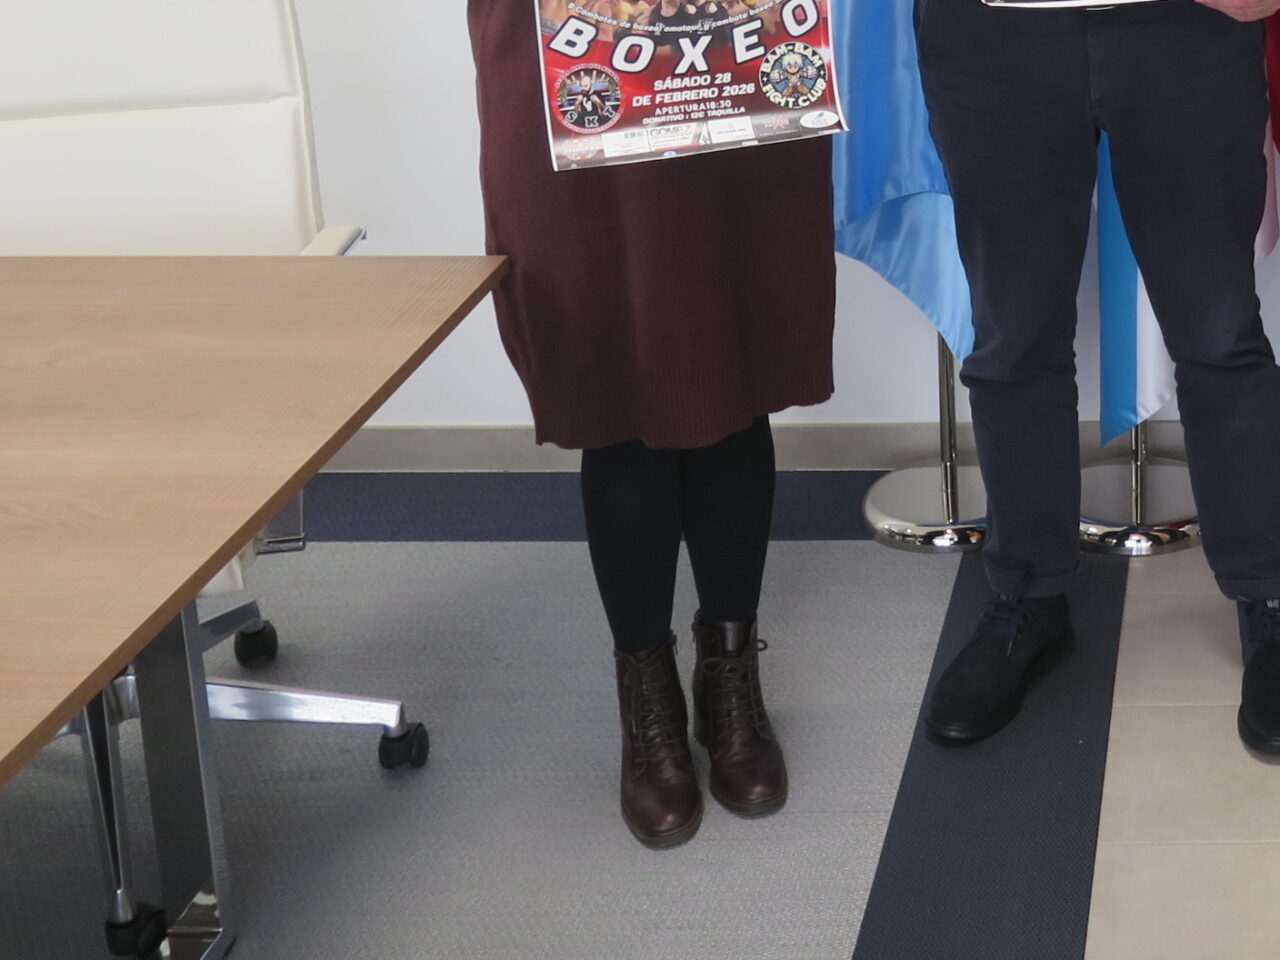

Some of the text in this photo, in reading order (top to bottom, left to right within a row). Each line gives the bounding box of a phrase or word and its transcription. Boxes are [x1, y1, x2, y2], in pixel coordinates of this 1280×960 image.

[619, 21, 631, 29] de
[712, 12, 748, 27] combate
[749, 1, 774, 16] boxeo
[761, 43, 824, 74] BAM-BAM
[653, 72, 732, 91] SÁBADO 28
[761, 77, 827, 108] FIGHT CLUB
[632, 83, 756, 107] DE FEBRERO 2026
[564, 106, 616, 128] SKT
[642, 106, 745, 125] DONATIVO TAQUILLA
